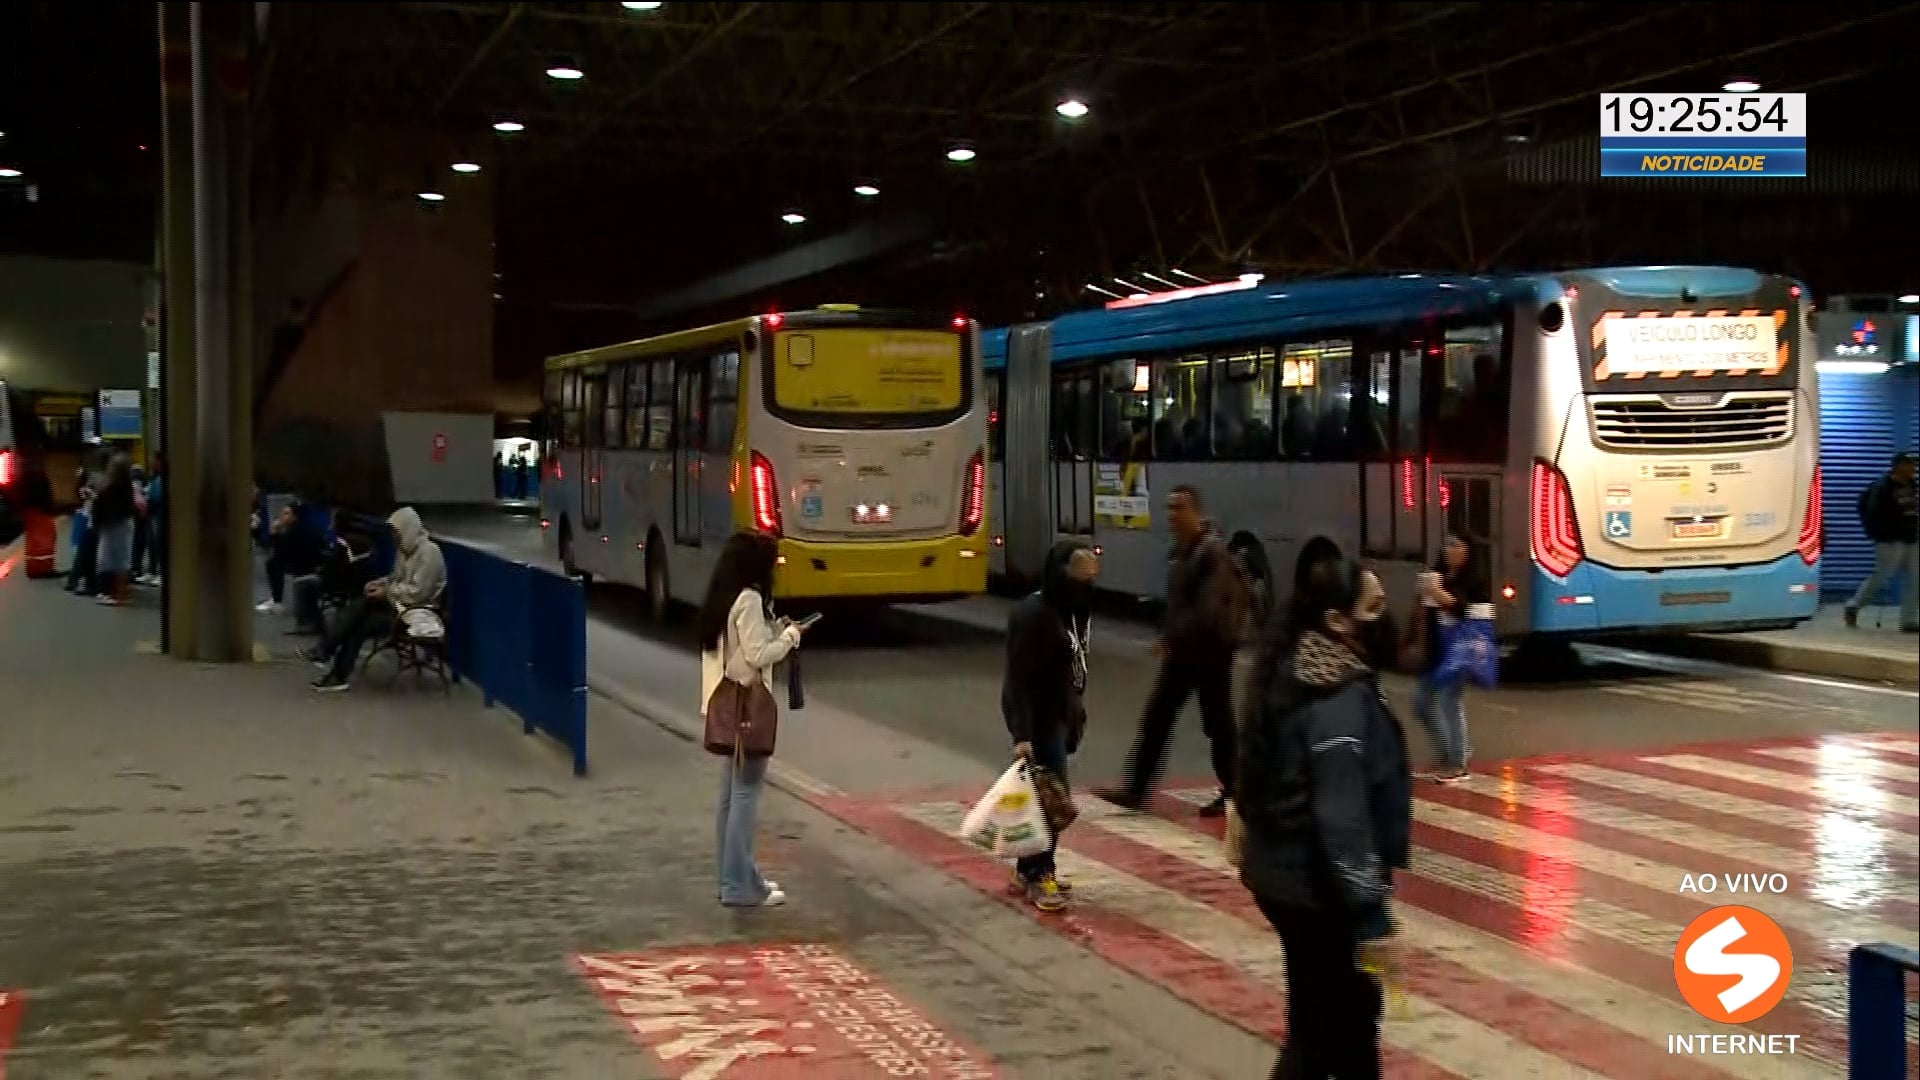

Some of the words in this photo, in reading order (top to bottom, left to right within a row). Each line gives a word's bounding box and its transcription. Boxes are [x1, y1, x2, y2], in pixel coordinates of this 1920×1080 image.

[1702, 323, 1758, 341] LONGO
[808, 1002, 932, 1075] PEDESTRES
[847, 988, 968, 1057] ATRAVESSE
